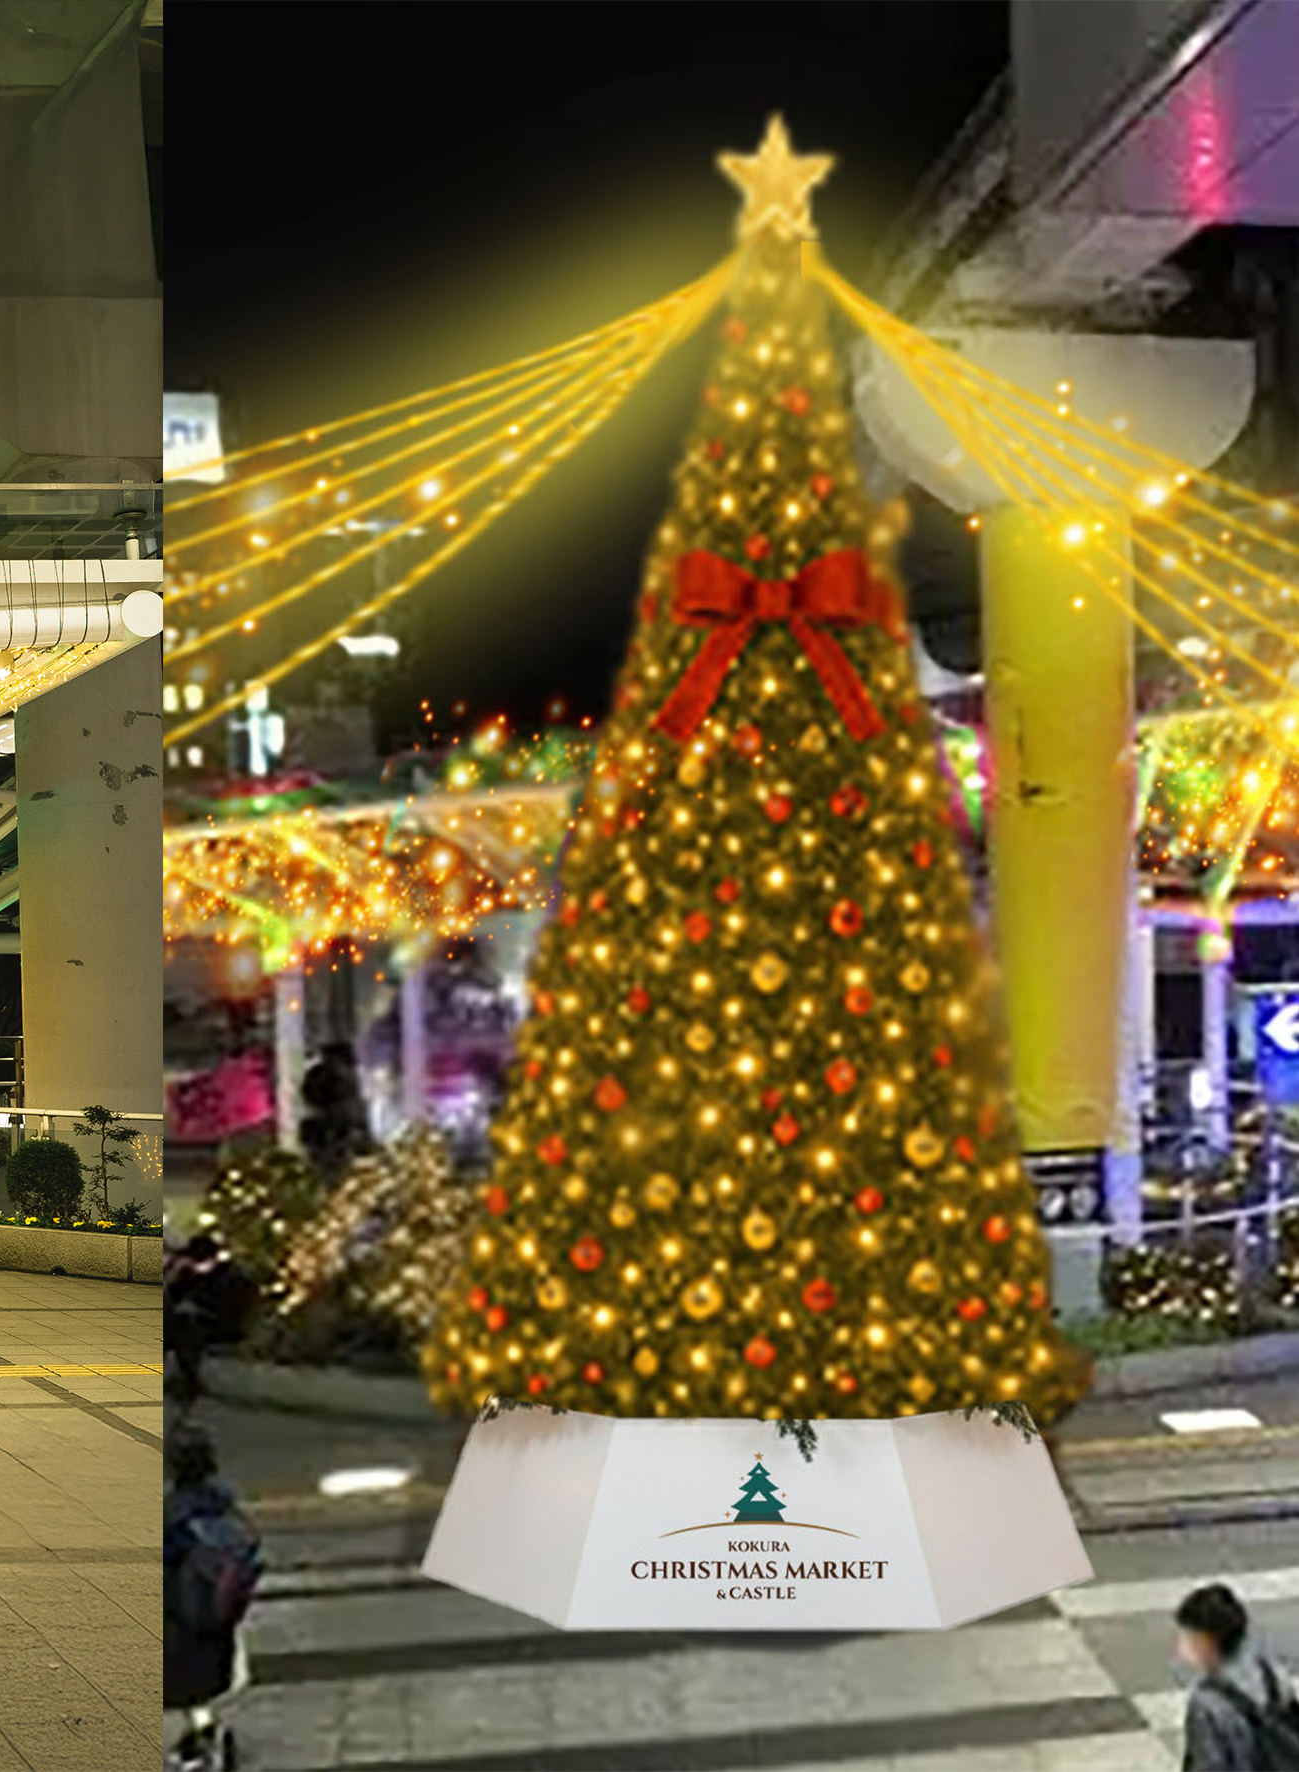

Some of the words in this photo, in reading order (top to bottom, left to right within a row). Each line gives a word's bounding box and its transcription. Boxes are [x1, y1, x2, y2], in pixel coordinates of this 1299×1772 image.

[728, 1540, 790, 1552] KOKURA
[631, 1560, 778, 1580] CHRISTMAS
[785, 1560, 889, 1580] MARKET
[729, 1586, 797, 1600] CASTLE
